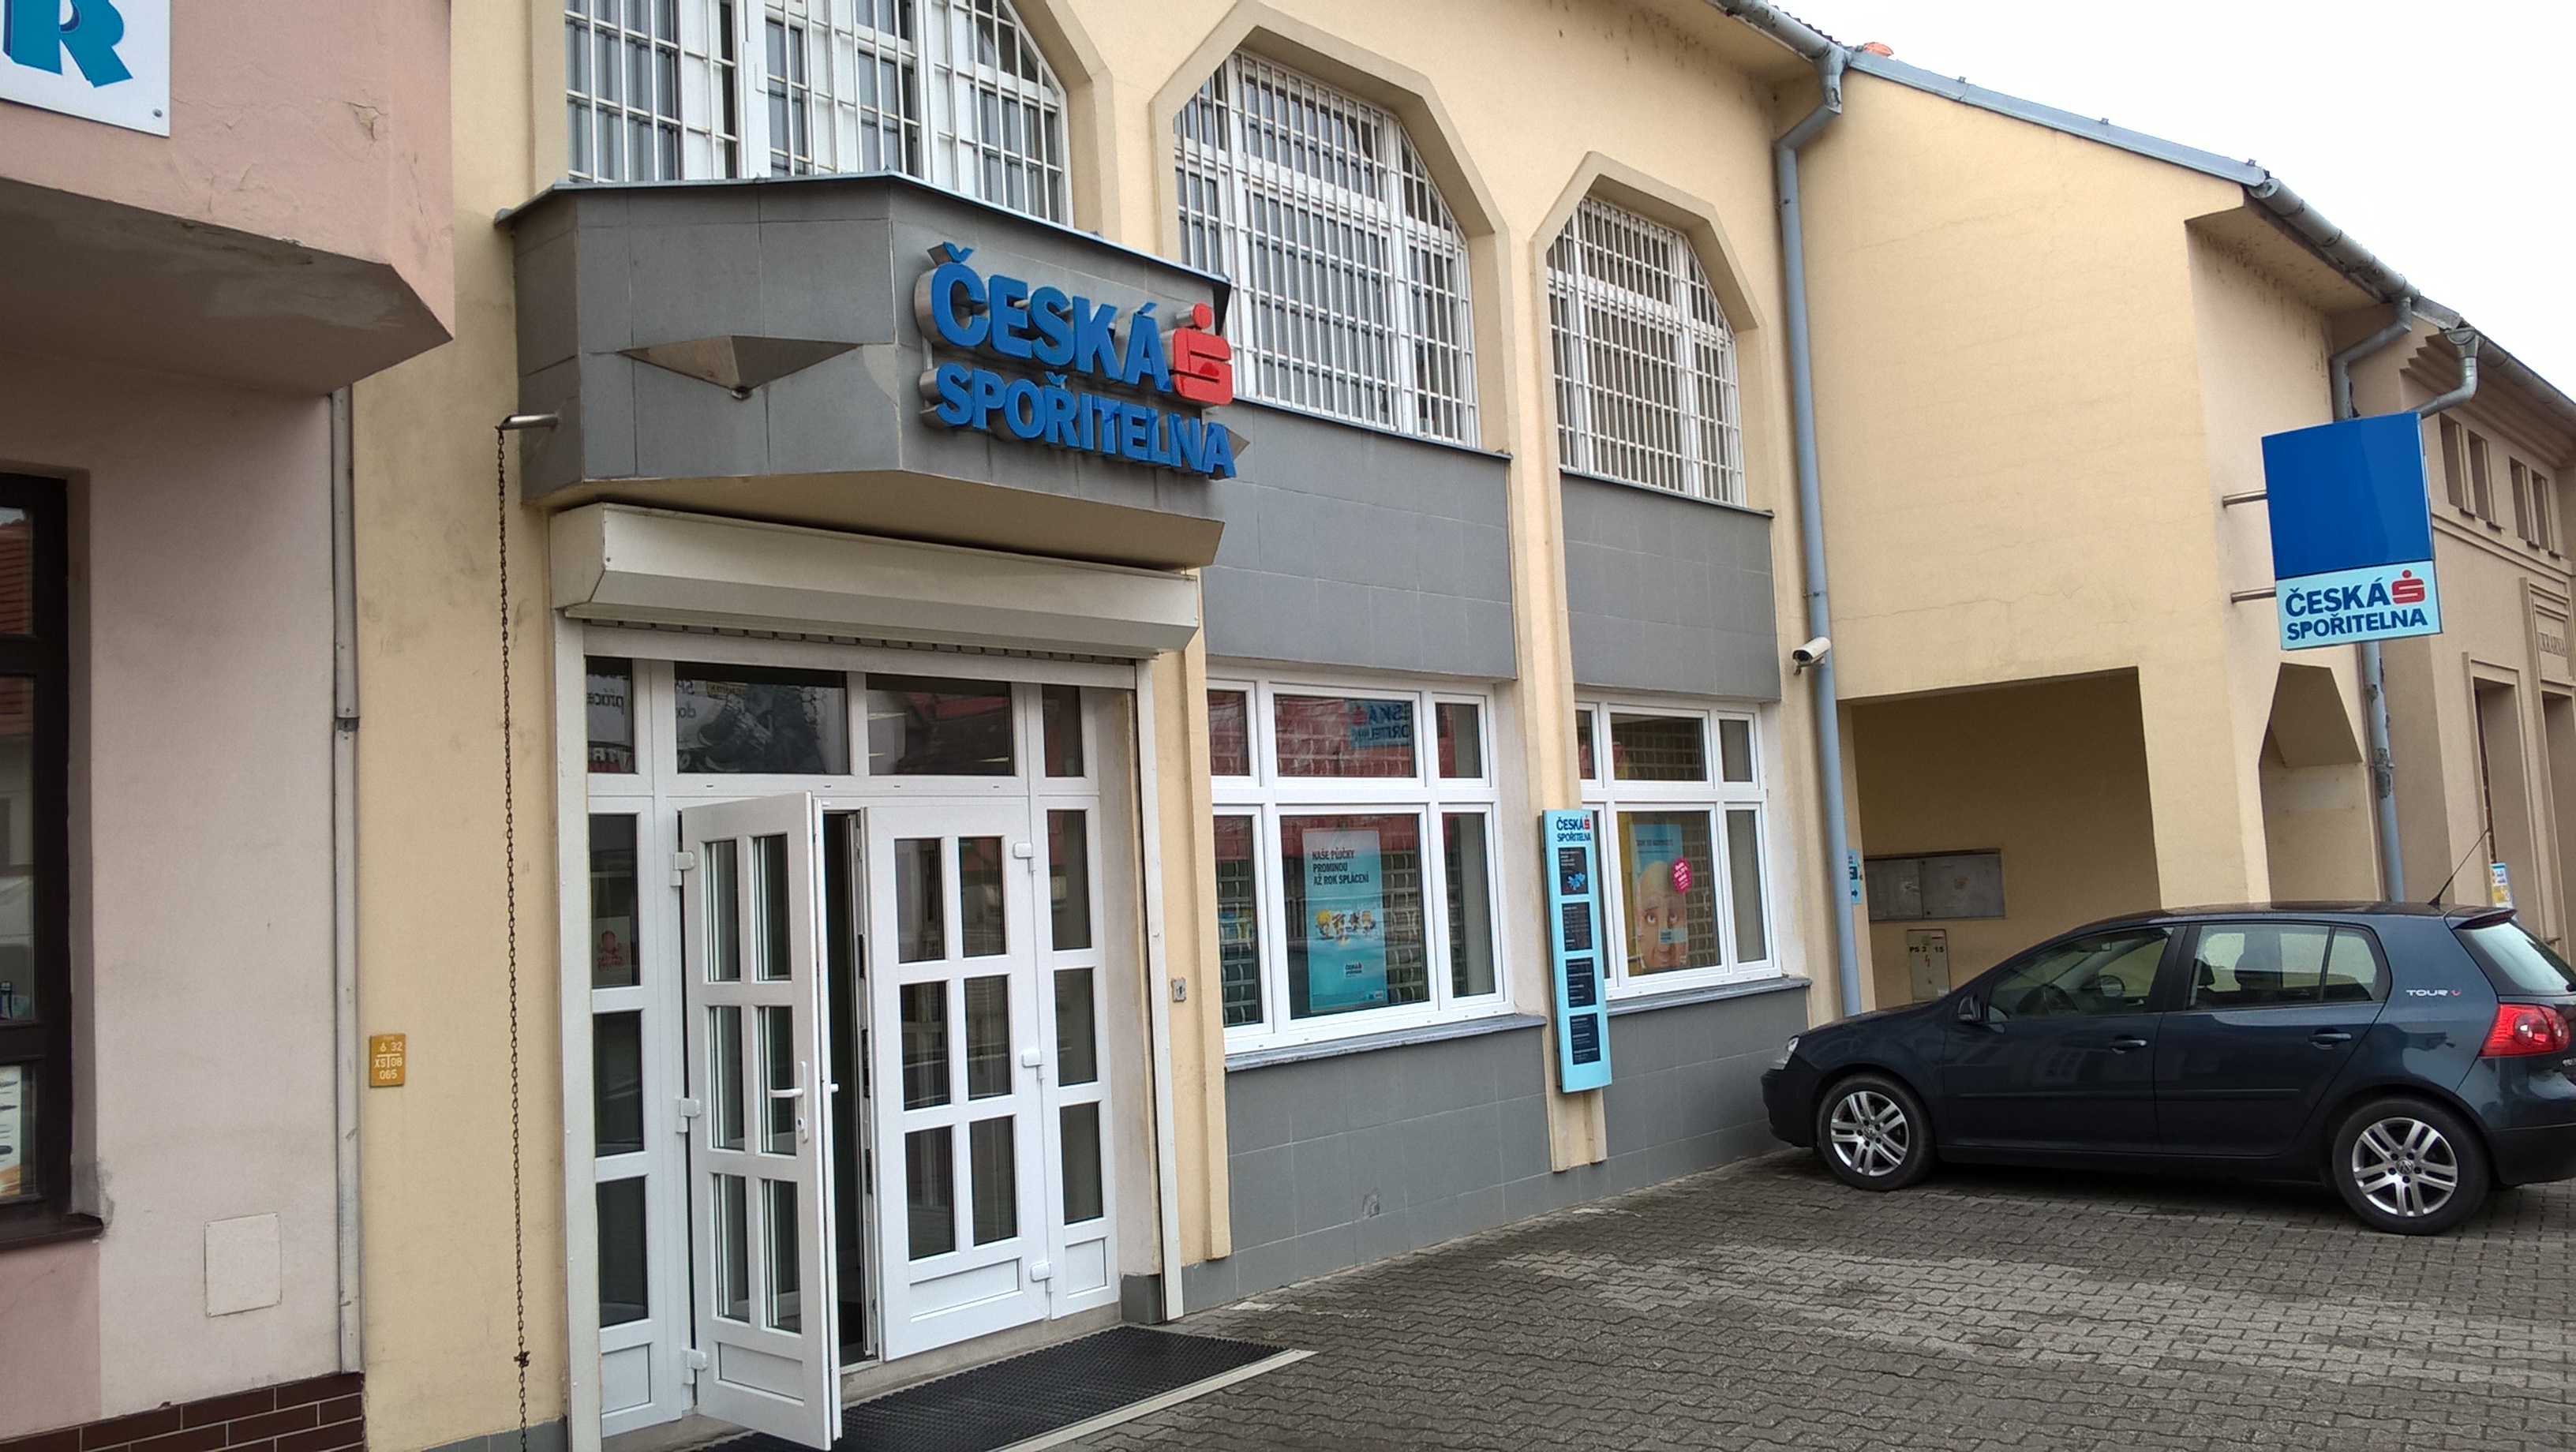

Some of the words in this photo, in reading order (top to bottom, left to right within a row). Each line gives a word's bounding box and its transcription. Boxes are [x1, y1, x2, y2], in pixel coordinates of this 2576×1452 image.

[928, 241, 1174, 393] ČESKÁ
[934, 361, 1237, 479] SPOŘITELNA
[2285, 576, 2391, 617] ČESKÁ
[2286, 607, 2428, 641] SPOŘITELNA
[1556, 817, 1585, 831] ČESKÁ
[1312, 848, 1329, 860] NAŠE
[1313, 863, 1348, 873] PROMINOU
[1313, 874, 1322, 885] AŽ
[1324, 875, 1337, 885] ROK
[1339, 872, 1369, 884] SPLÁCENÍ
[391, 1041, 402, 1052] 32
